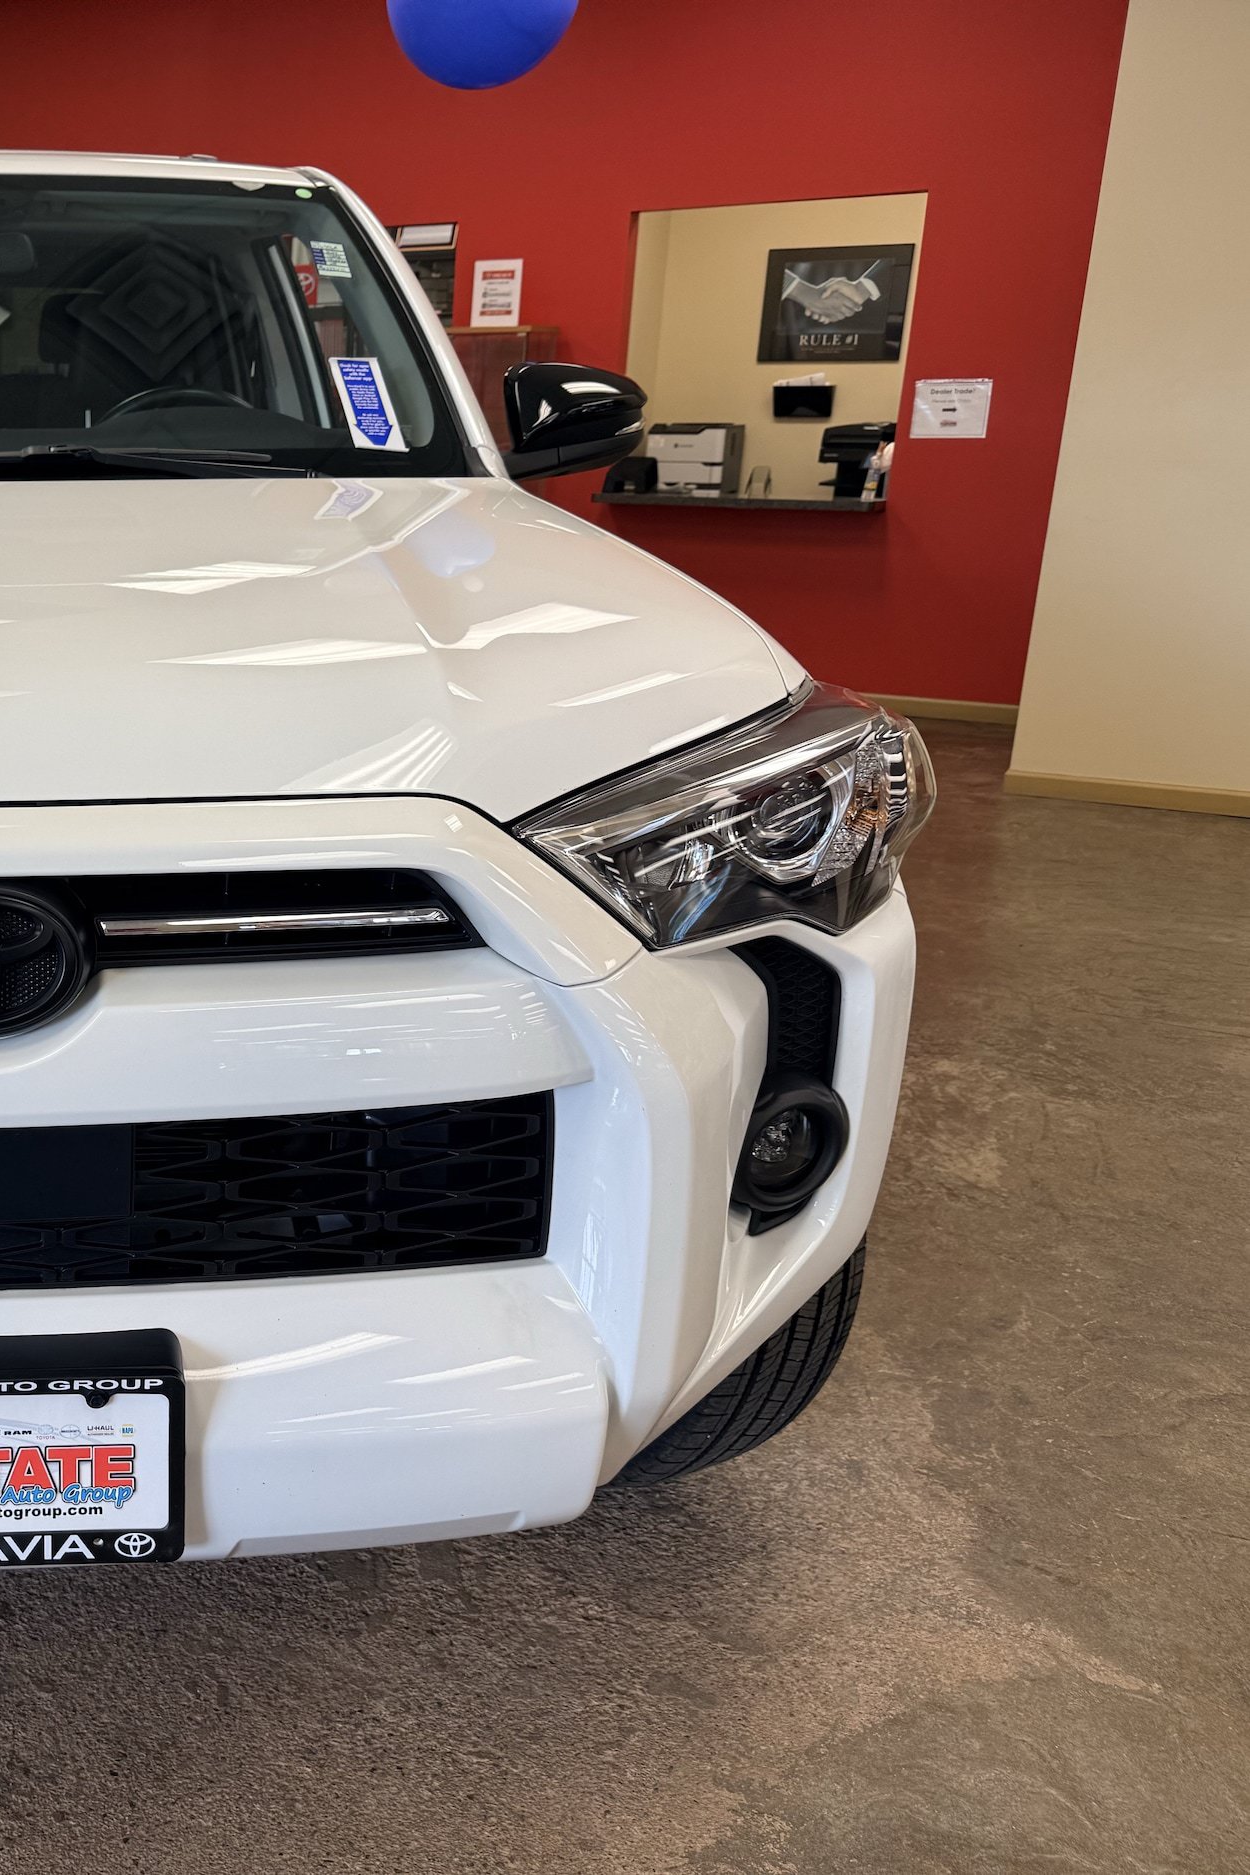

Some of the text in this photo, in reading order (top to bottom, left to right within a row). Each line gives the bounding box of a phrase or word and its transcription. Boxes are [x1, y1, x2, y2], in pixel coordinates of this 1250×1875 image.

[799, 333, 842, 346] RULE
[47, 1378, 164, 1391] GROUP
[62, 1482, 134, 1509] Group
